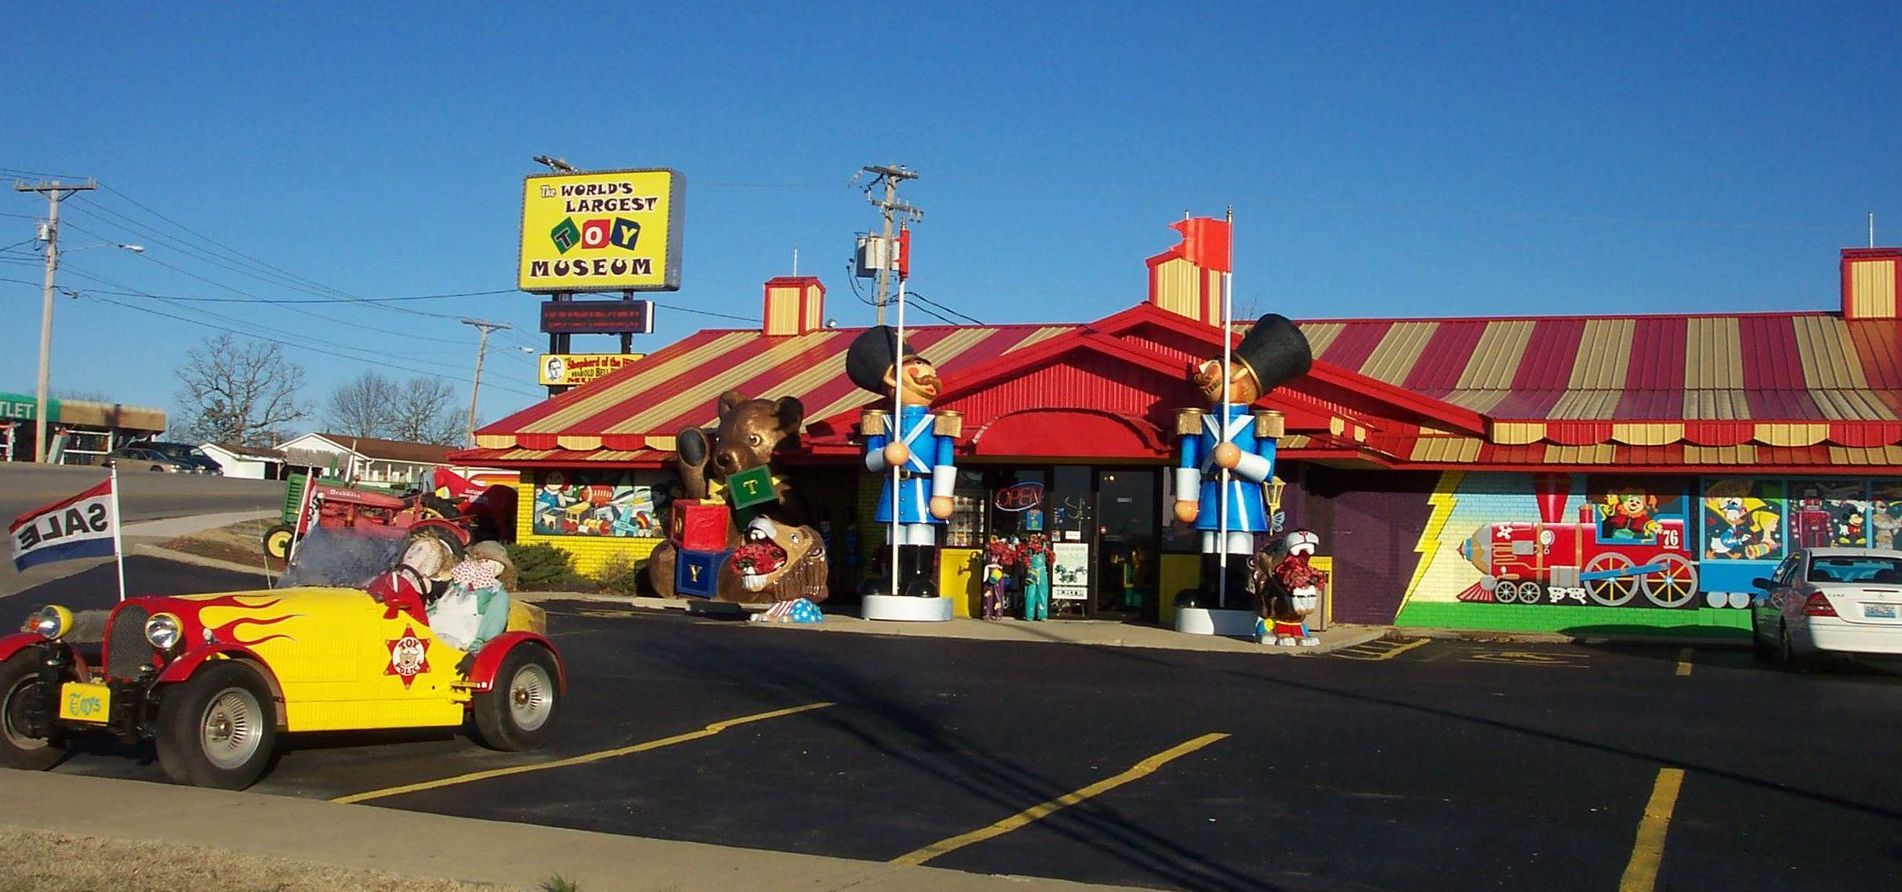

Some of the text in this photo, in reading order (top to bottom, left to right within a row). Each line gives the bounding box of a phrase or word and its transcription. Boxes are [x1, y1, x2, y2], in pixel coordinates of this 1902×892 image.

[541, 183, 633, 198] The WORLD'S
[565, 197, 658, 213] LARGEST
[555, 225, 637, 249] TOY
[530, 258, 652, 277] MUSEUM
[601, 356, 608, 367] of
[610, 356, 621, 367] the
[743, 480, 758, 495] T
[996, 487, 1041, 507] OPEN
[1663, 529, 1679, 546] 76
[688, 564, 702, 582] Y
[399, 639, 419, 650] TOY
